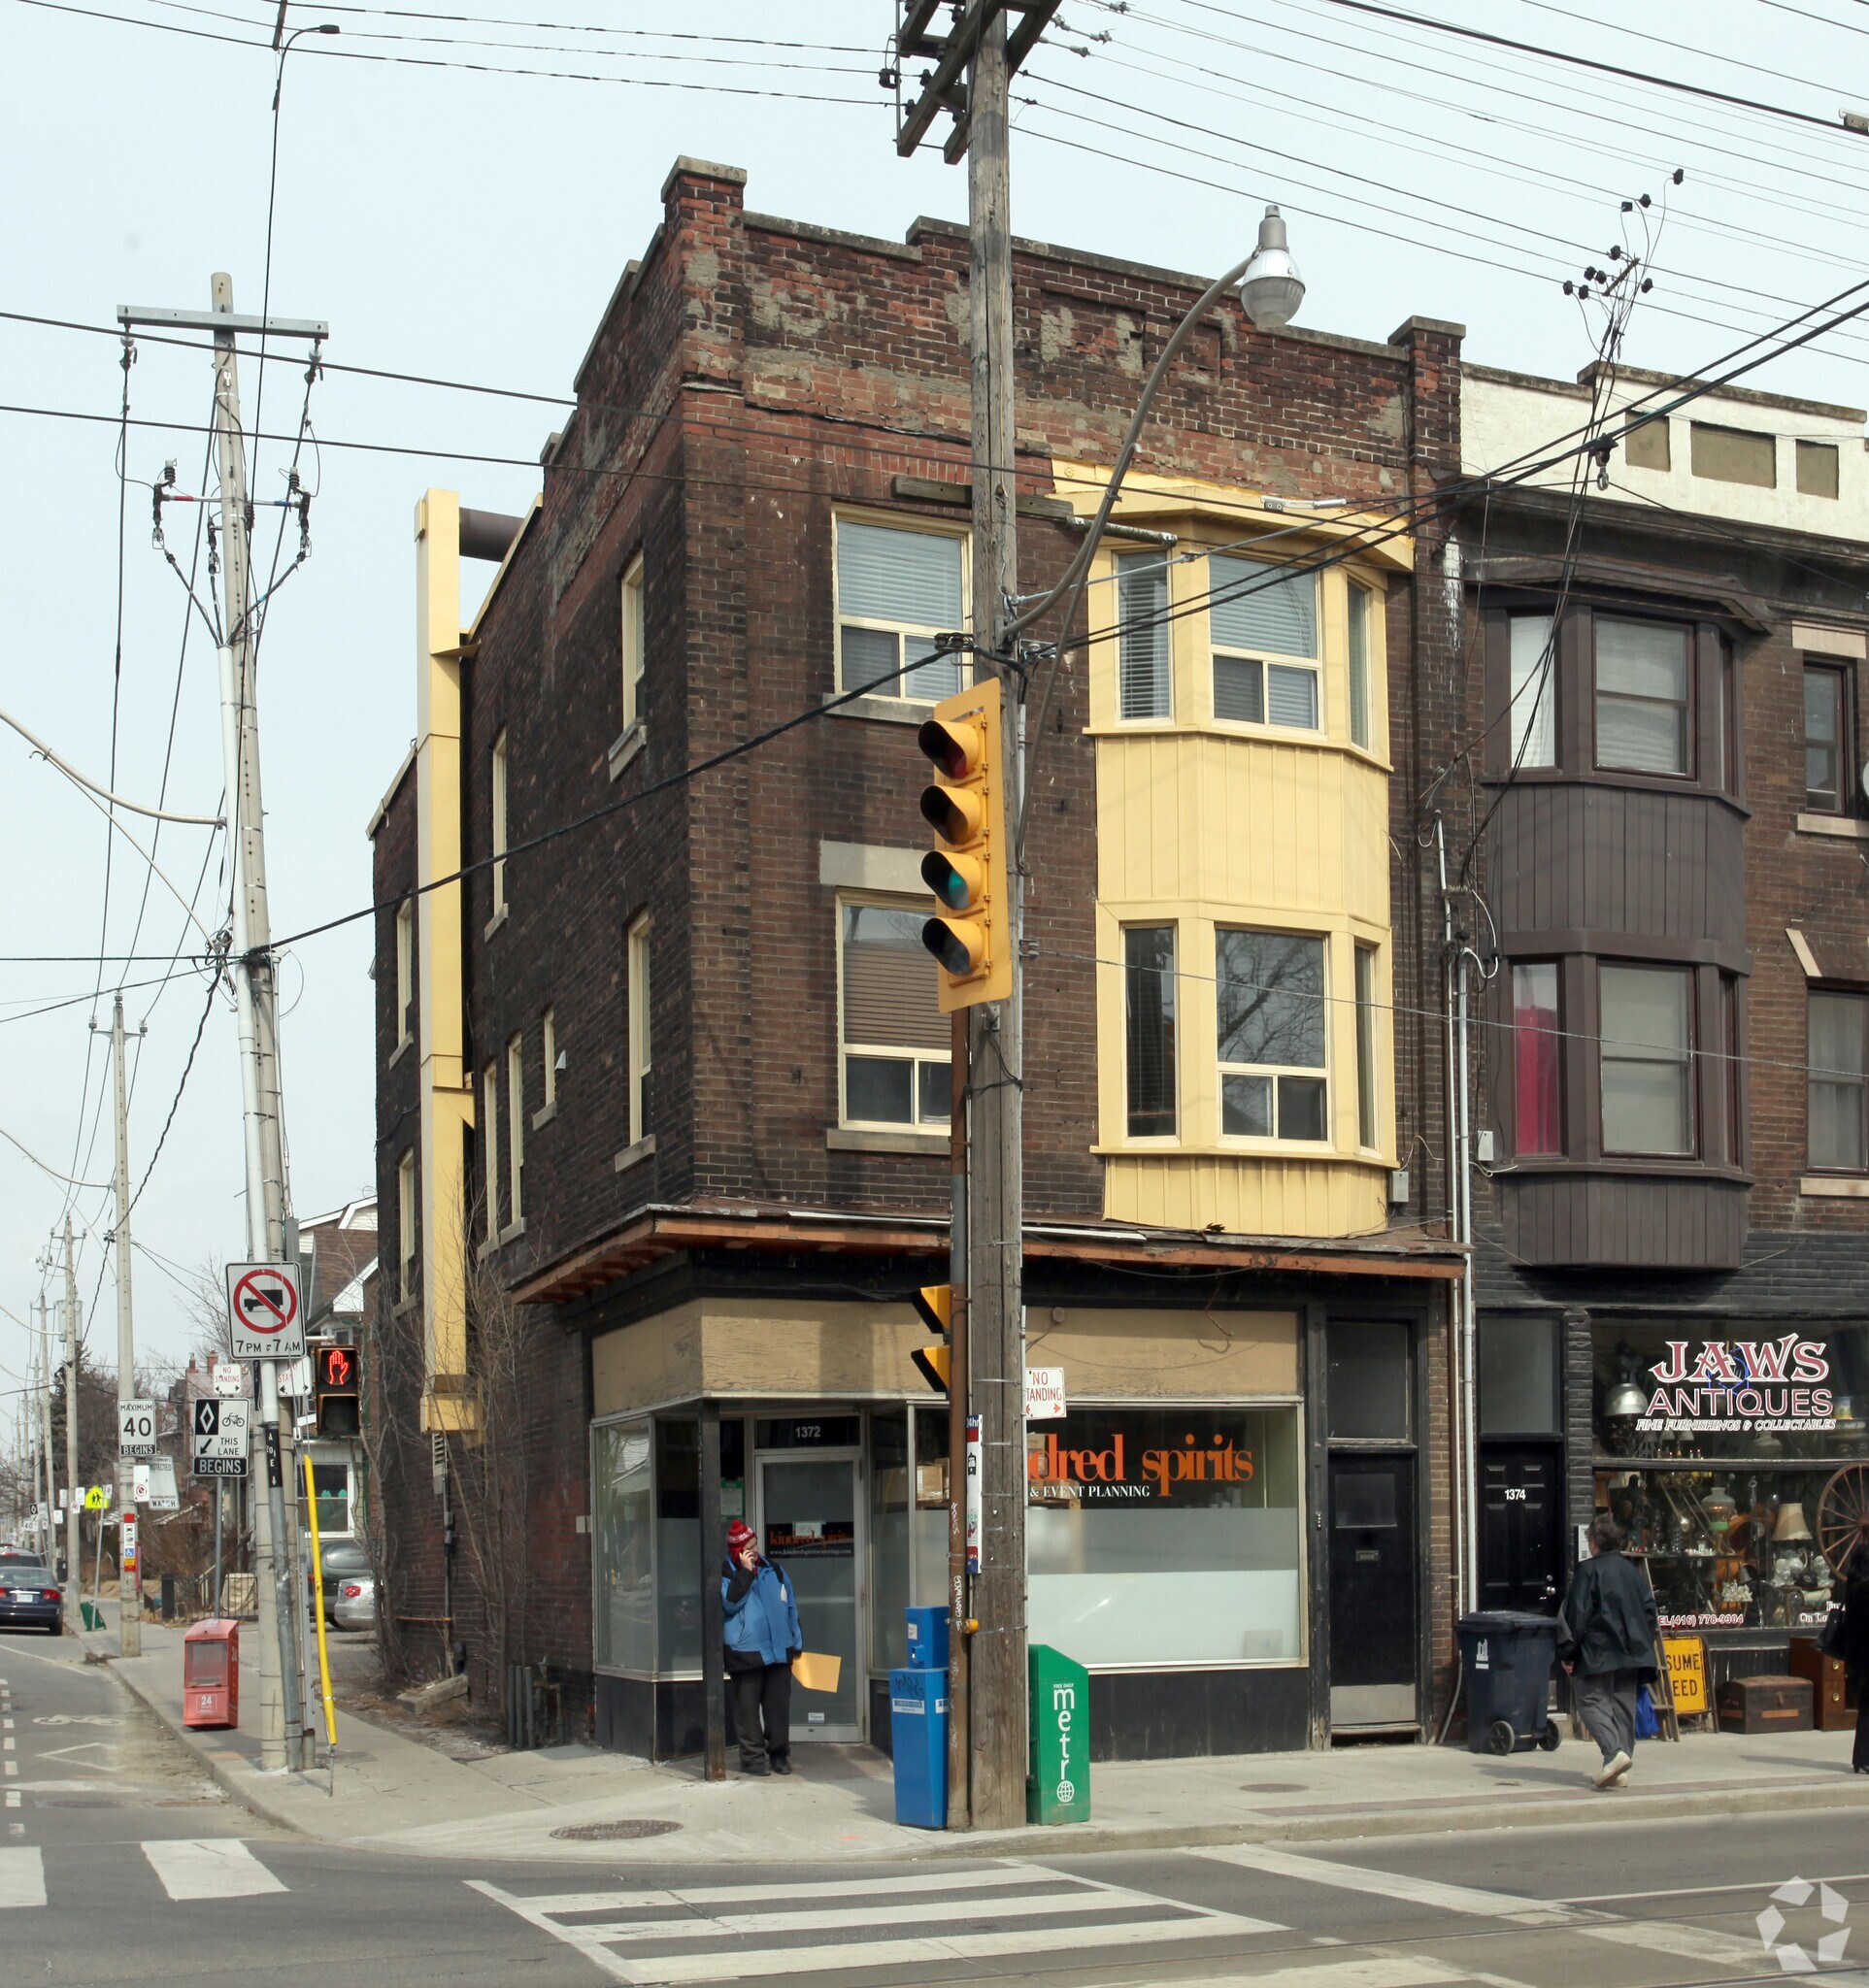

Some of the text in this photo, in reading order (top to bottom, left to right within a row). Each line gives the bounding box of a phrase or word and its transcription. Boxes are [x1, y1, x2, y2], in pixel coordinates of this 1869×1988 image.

[236, 1341, 244, 1353] 7
[247, 1342, 261, 1352] PM
[273, 1340, 281, 1352] 7
[284, 1342, 300, 1352] AM
[1648, 1332, 1829, 1383] JAWS
[1032, 1372, 1049, 1385] NO
[1026, 1387, 1062, 1402] TANDING
[1645, 1387, 1834, 1417] ANTIQUES
[123, 1417, 151, 1437] 40
[796, 1426, 821, 1438] 1372
[1635, 1419, 1836, 1432] FINE FURNISHINGS & COLLECTABLES
[123, 1445, 153, 1455] BEGINS
[199, 1460, 242, 1474] BEGINS
[1027, 1433, 1254, 1497] dred spirits
[1029, 1485, 1151, 1497] & EVENT PLANNING
[1504, 1488, 1526, 1501] 1374
[1657, 1615, 1696, 1627] EL(416)
[1666, 1653, 1700, 1671] SUME
[1672, 1679, 1698, 1697] EED
[201, 1696, 212, 1706] 24
